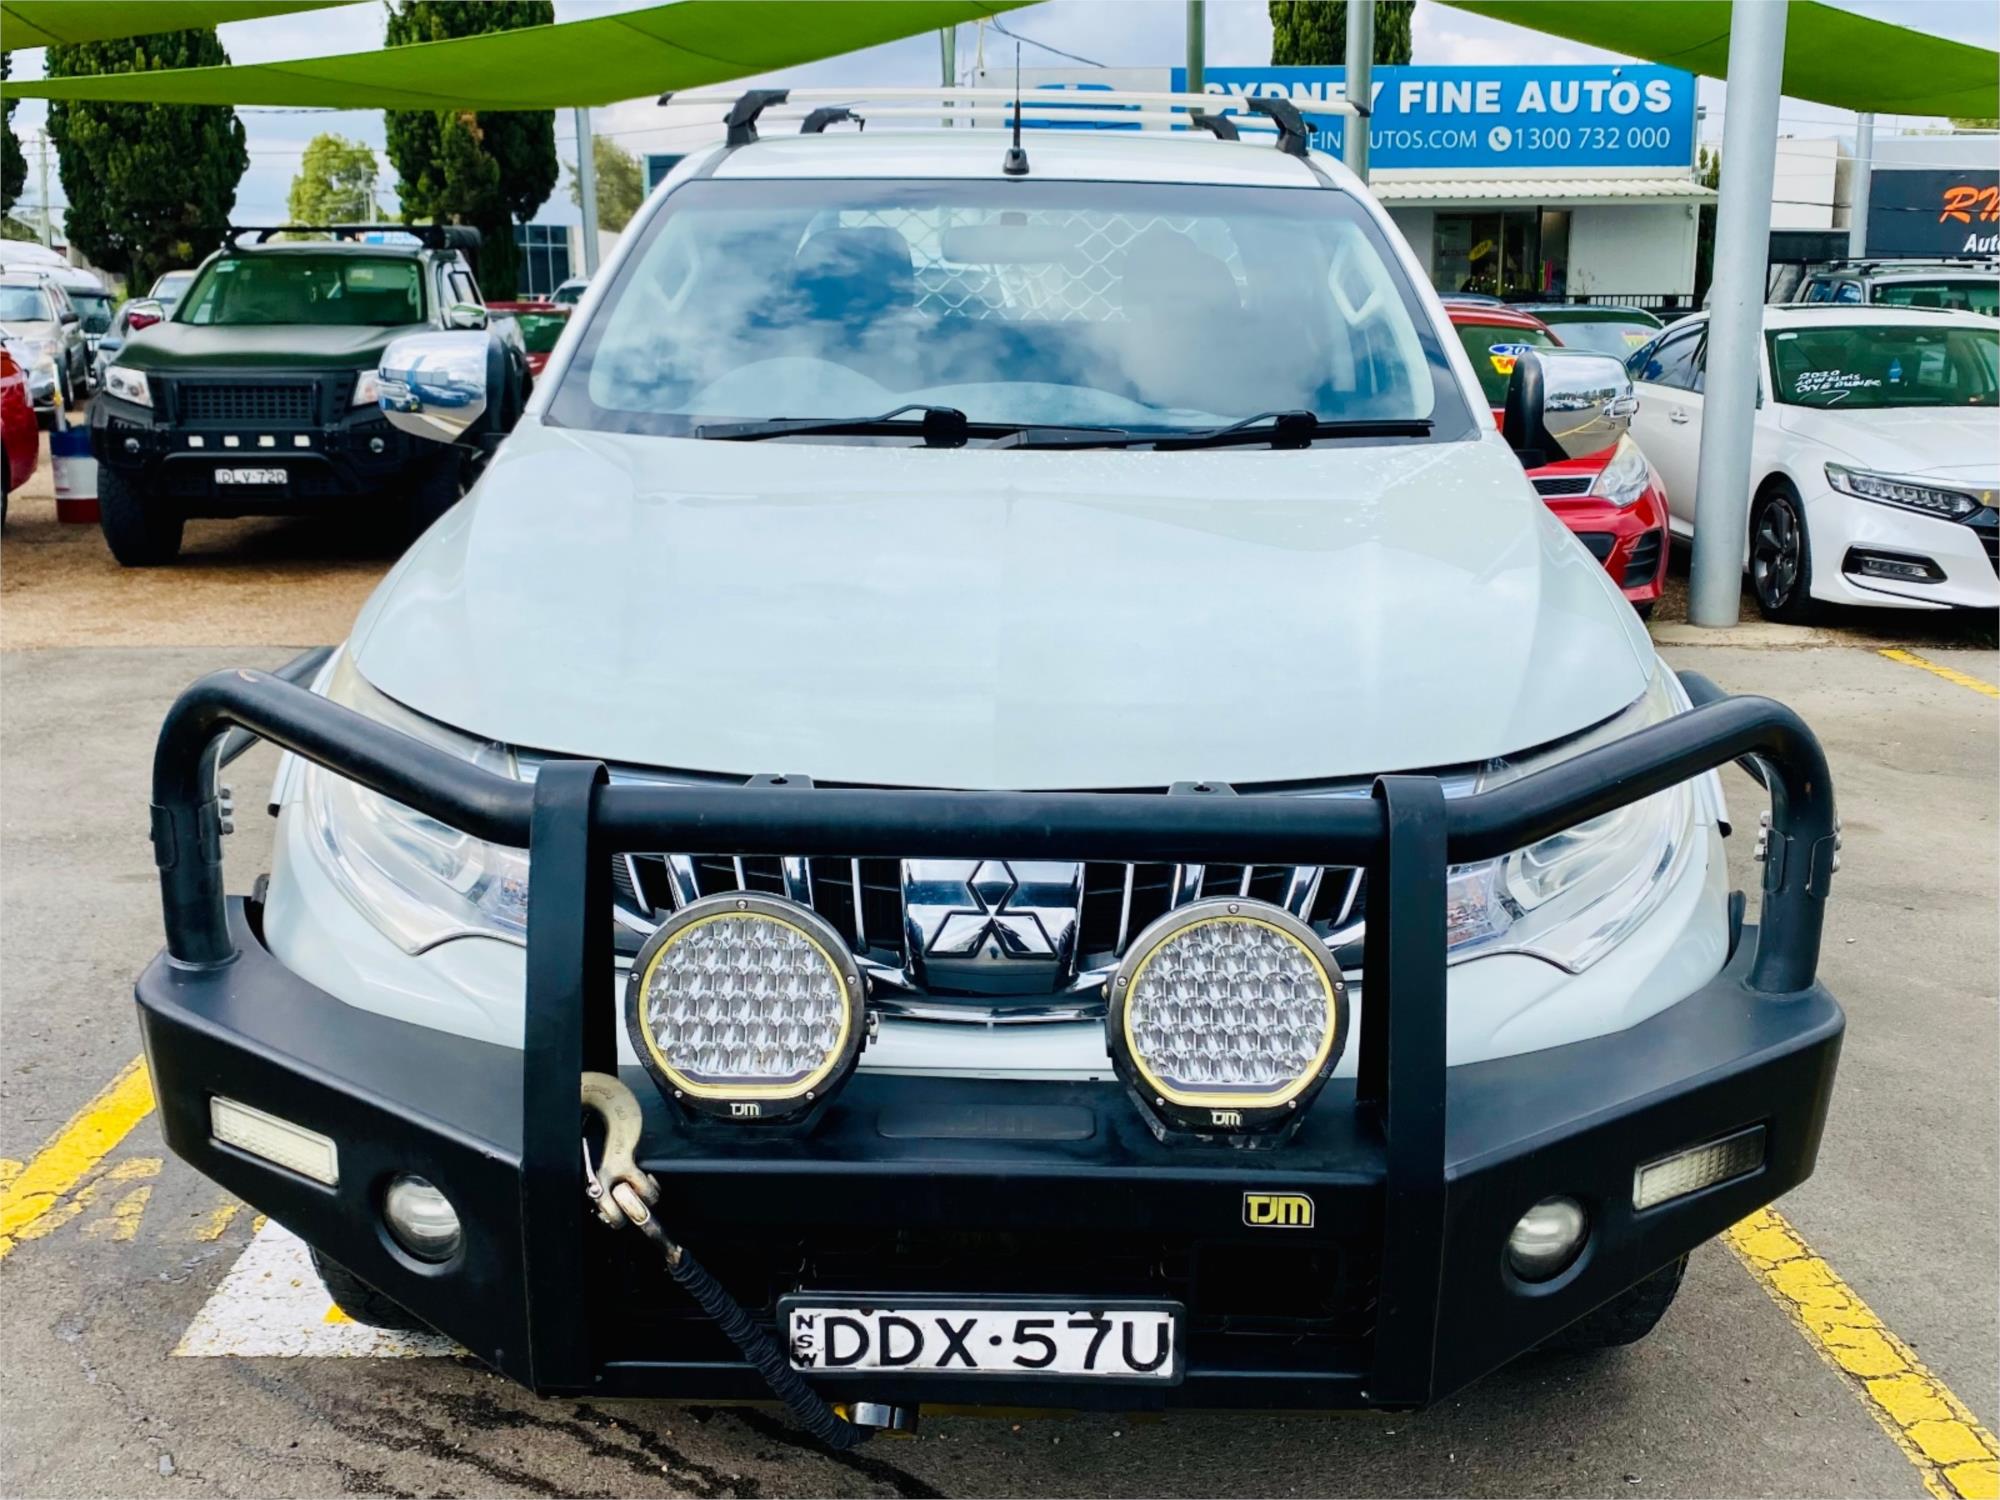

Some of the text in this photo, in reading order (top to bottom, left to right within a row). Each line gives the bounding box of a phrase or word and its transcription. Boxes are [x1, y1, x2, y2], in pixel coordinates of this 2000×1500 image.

[1400, 81, 1502, 114] FINE
[1516, 79, 1672, 115] AUTOS
[1307, 129, 1477, 150] FINUTOS.COM
[1514, 127, 1671, 150] 1300 732 000
[1963, 233, 1999, 253] Aut
[730, 1102, 760, 1116] TJM
[1210, 1110, 1242, 1126] TJM
[1247, 1195, 1311, 1225] TJM
